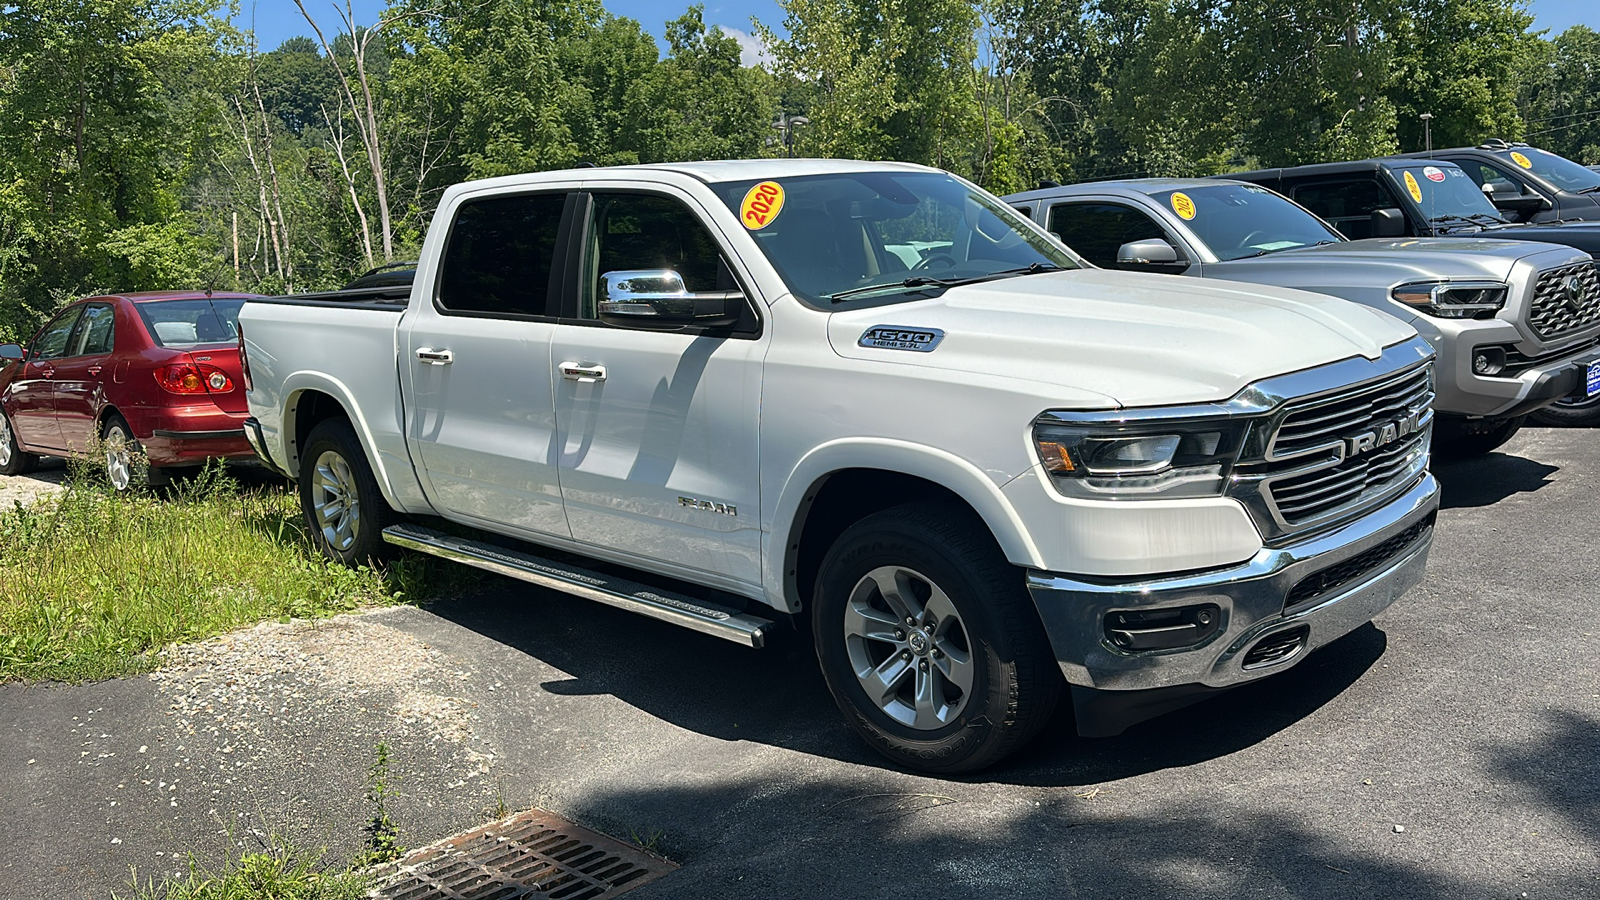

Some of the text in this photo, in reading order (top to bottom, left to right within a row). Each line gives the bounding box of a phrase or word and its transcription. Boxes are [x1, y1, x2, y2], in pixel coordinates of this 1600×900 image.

[746, 185, 778, 225] 2020
[868, 329, 932, 343] 1500
[872, 340, 898, 348] HEMI
[1343, 409, 1419, 457] RAM
[677, 495, 738, 516] RAM
